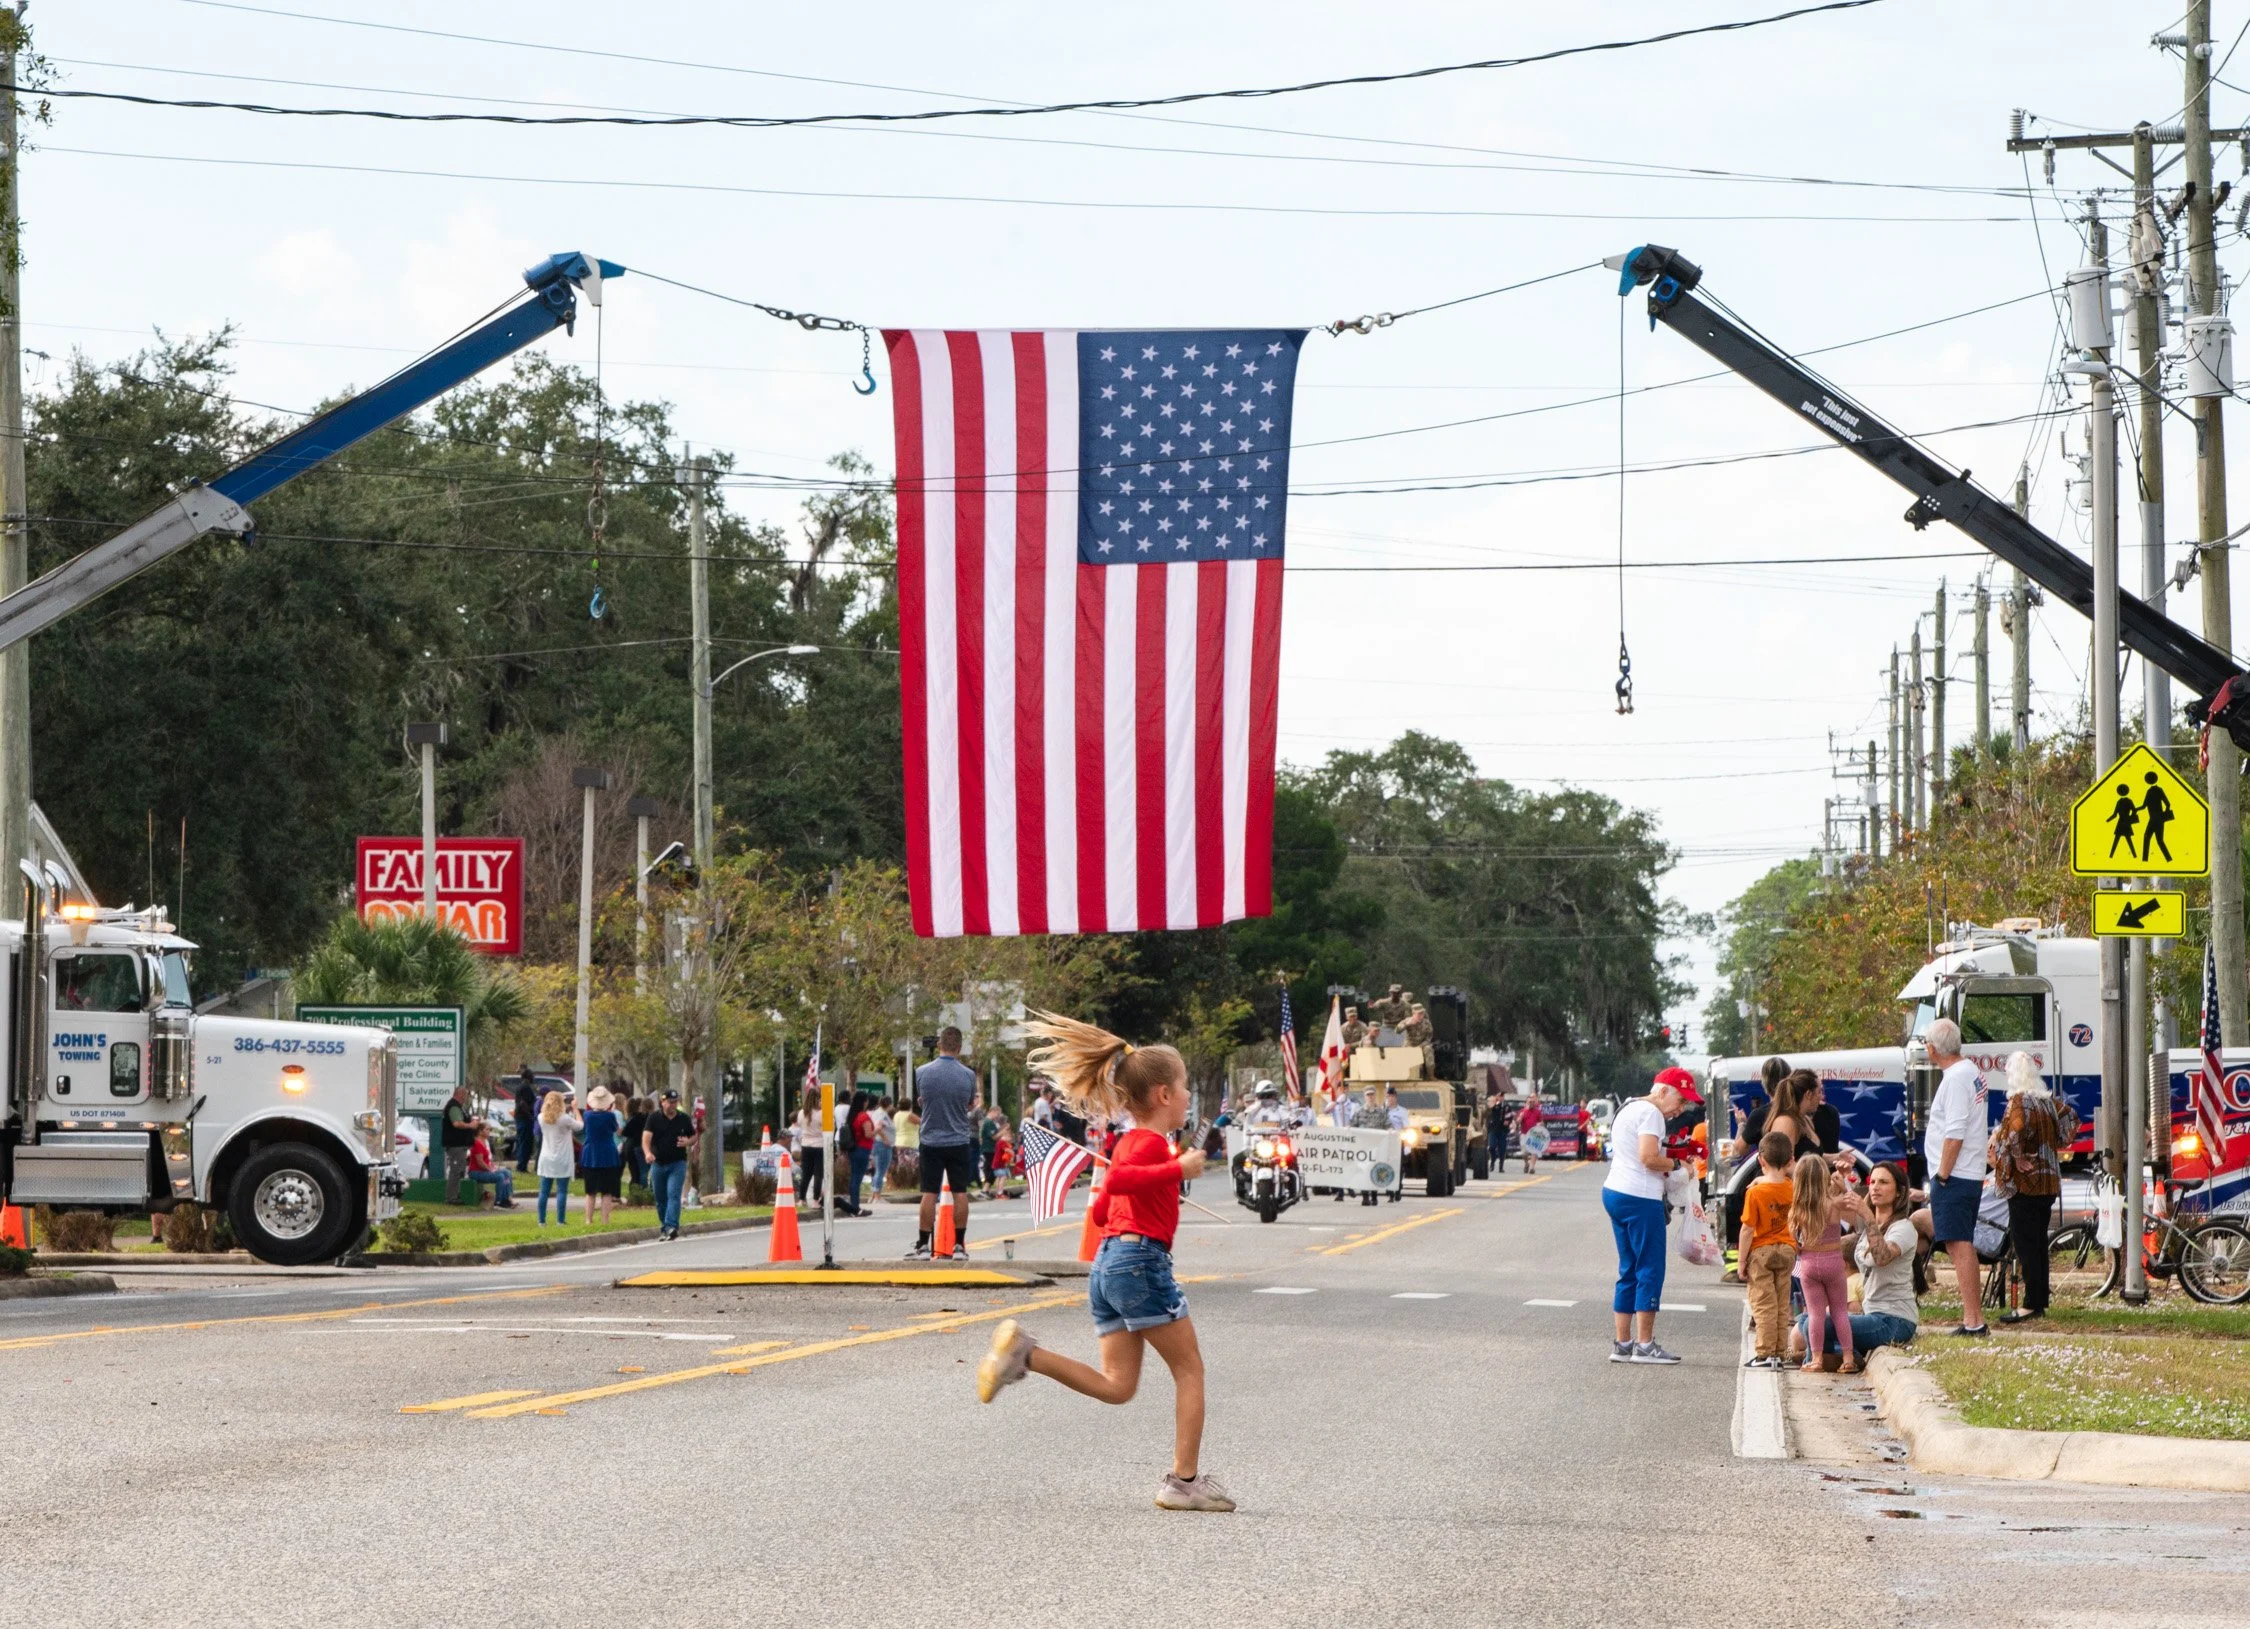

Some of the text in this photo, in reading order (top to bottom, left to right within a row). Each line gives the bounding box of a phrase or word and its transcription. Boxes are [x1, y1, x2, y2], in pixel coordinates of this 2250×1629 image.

[1822, 395, 1843, 416] This
[330, 1016, 399, 1027] Professional
[403, 1016, 453, 1030] Building
[52, 1033, 107, 1048] JOHN'S
[2070, 1027, 2092, 1044] 72
[234, 1037, 346, 1055] 386-437-5555
[423, 1038, 452, 1048] Families
[58, 1051, 101, 1061] TOWING
[418, 1059, 449, 1069] County
[416, 1070, 441, 1079] Clinic
[409, 1087, 450, 1095] Salvation
[417, 1097, 441, 1107] Army
[1304, 1132, 1357, 1143] AUGUSTINE
[1296, 1148, 1377, 1162] AIR PATROL
